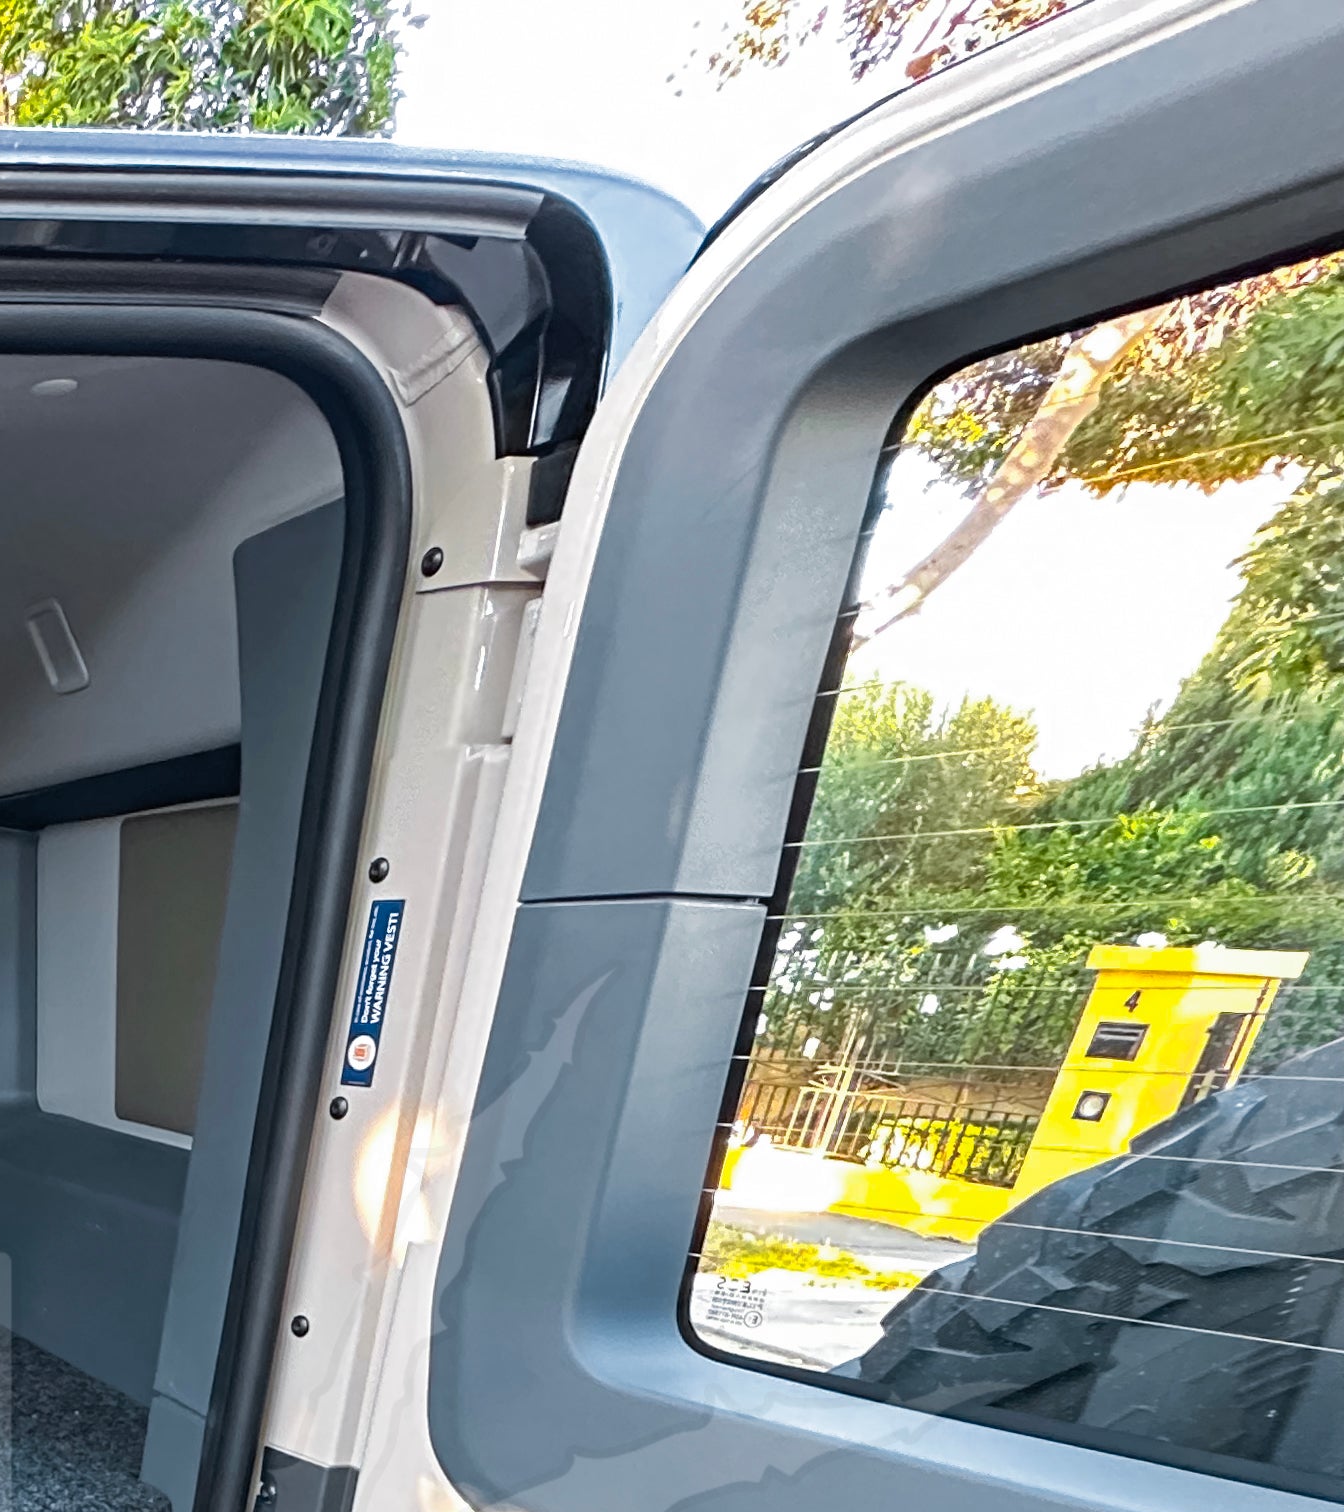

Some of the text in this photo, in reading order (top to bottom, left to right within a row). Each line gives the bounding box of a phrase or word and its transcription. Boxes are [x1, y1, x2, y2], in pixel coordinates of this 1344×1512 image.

[365, 963, 378, 995] forget
[370, 954, 392, 1024] WARNING
[1124, 990, 1141, 1012] 4
